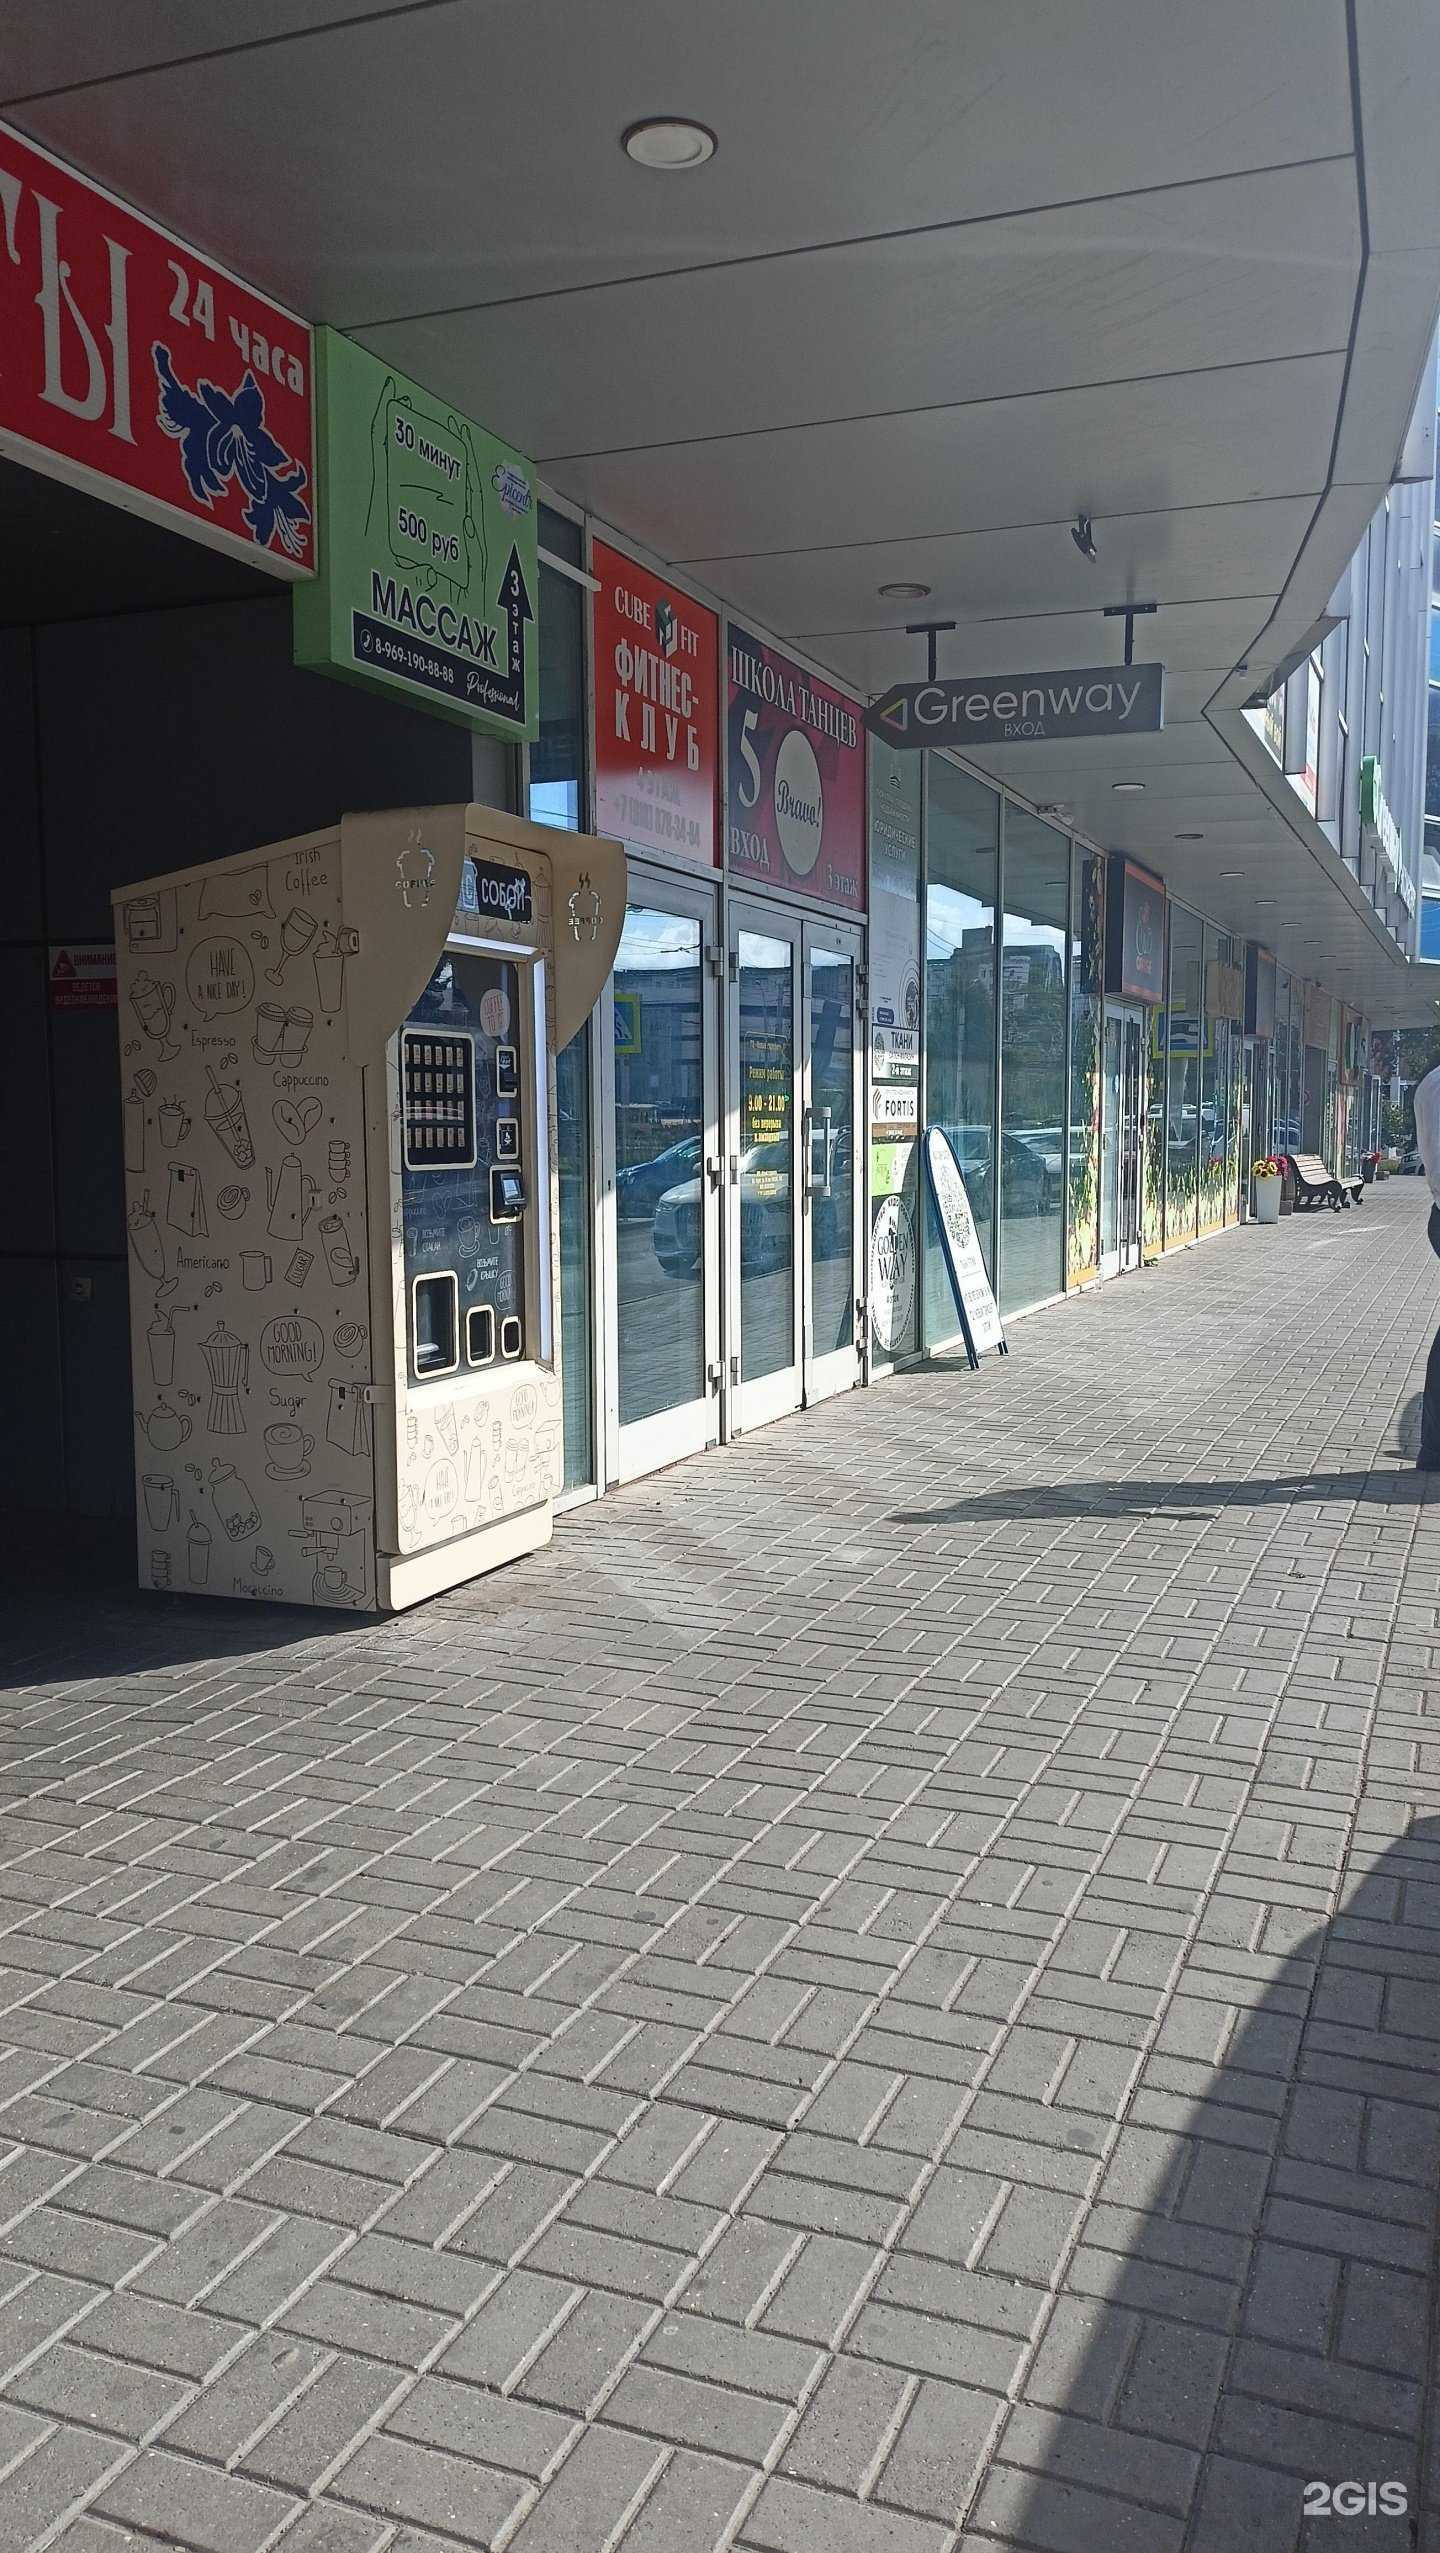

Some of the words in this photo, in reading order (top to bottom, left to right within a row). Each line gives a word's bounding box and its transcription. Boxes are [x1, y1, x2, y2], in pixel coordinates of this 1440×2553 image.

[167, 259, 215, 342] 24
[229, 314, 304, 397] часа
[395, 417, 415, 450] 30
[419, 437, 462, 480] минут
[399, 508, 427, 543] 500
[432, 531, 459, 562] руб
[510, 570, 520, 596] 3
[372, 570, 498, 668] МАССАЖ
[614, 586, 652, 631] CUBE
[681, 624, 699, 657] FIT
[512, 604, 521, 673] этаж
[375, 638, 455, 685] 8-969-190-88-88
[466, 671, 520, 712] Professional
[614, 637, 699, 718] ФИТНЕС-
[731, 646, 797, 722] ШКОЛА
[798, 686, 857, 750] ТАНЦЕВ
[914, 681, 1141, 725] Greenway
[614, 689, 699, 772] КЛУБ
[1004, 721, 1046, 737] ВХОД
[776, 779, 822, 828] Bravo!
[295, 847, 321, 865] Irish
[729, 827, 771, 877] ВХОД
[285, 869, 328, 896] Coffee
[481, 878, 526, 911] СОБОЙ
[833, 872, 859, 897] этаж
[209, 948, 237, 977] HAVE
[206, 982, 225, 1000] NICE
[226, 980, 247, 1000] DAY!
[191, 1029, 236, 1052] Espresso
[891, 1031, 913, 1050] ТКАНИ
[272, 1070, 329, 1092] Cappuccino
[748, 1094, 763, 1112] 9.00
[768, 1094, 785, 1112] 21.00
[885, 1100, 914, 1116] FORTIS
[176, 1246, 230, 1270] Americano
[878, 1254, 908, 1281] WAY
[273, 1321, 302, 1343] GOOD
[267, 1342, 317, 1364] MORNING!
[269, 1387, 306, 1418] Sugar
